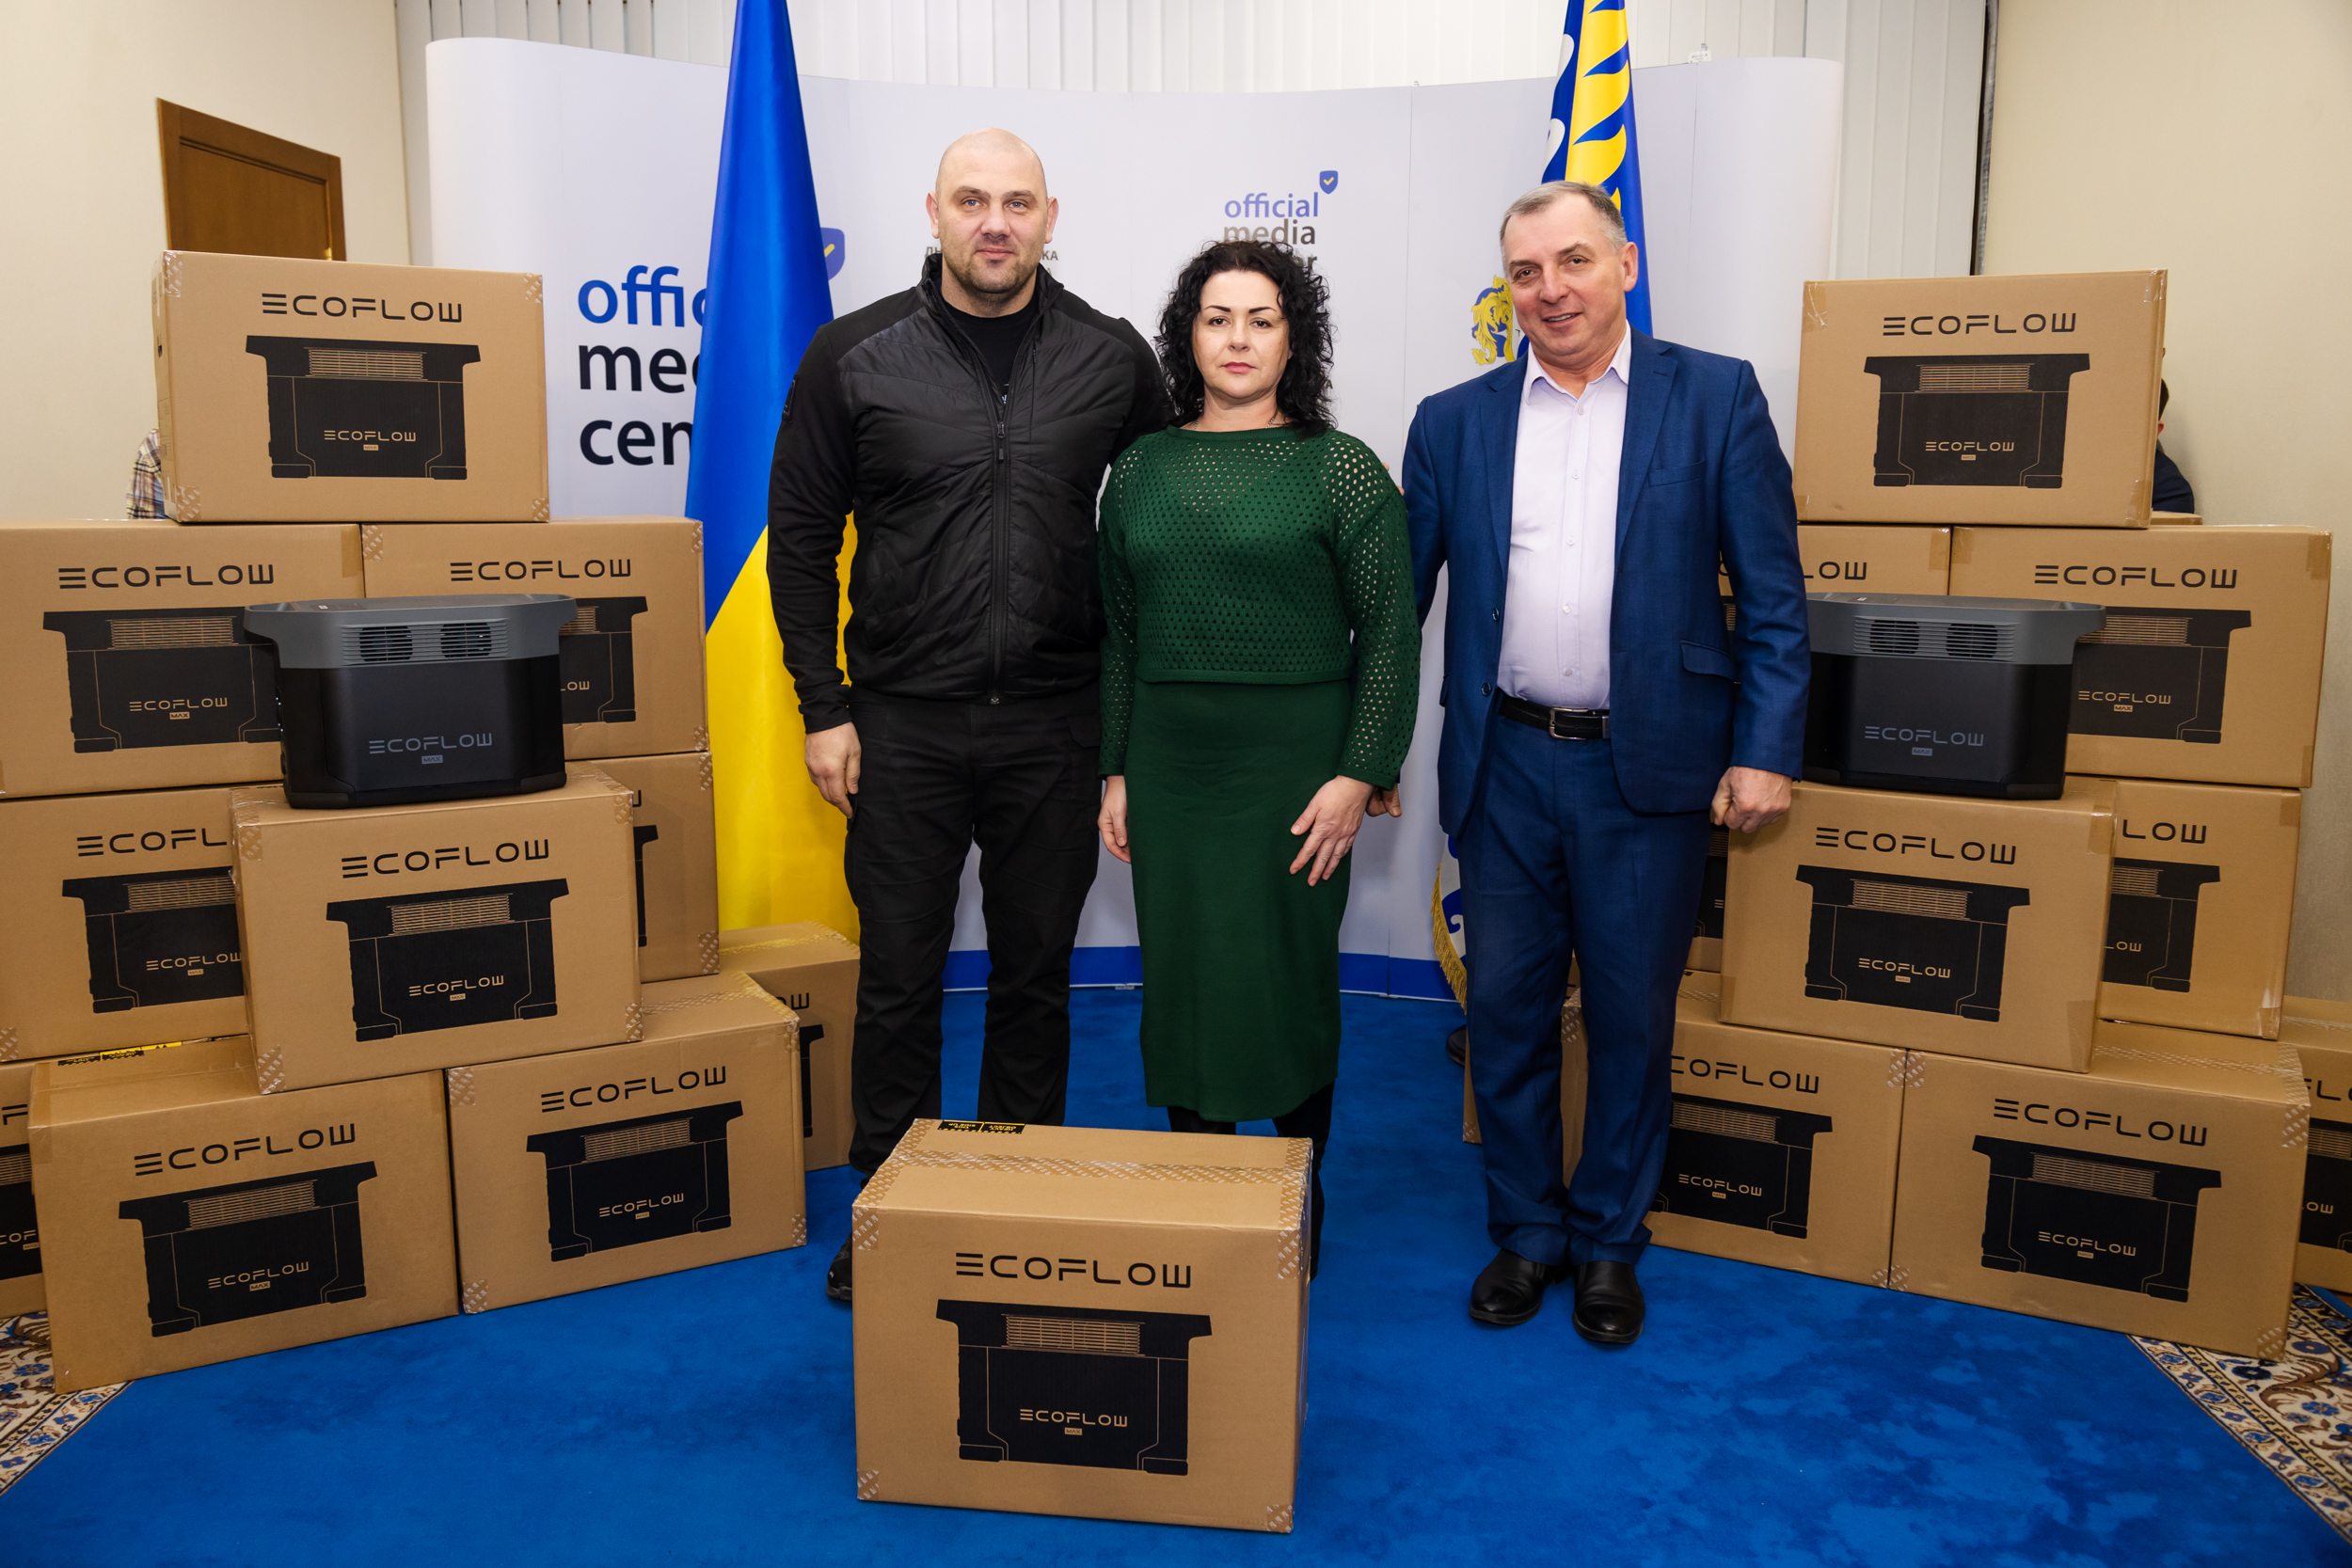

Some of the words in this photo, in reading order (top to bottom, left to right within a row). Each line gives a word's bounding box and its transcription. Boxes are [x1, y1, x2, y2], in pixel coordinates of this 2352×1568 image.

[1224, 191, 1319, 218] official
[1223, 218, 1316, 245] media
[261, 293, 463, 324] ECOFLOW
[1883, 312, 2076, 337] ECOFLOW
[324, 429, 417, 442] ECOFLOW
[1925, 440, 2015, 452] ECOFLOW
[57, 563, 275, 590] ECOFLOW
[450, 558, 631, 582] ECOFLOW
[2034, 564, 2238, 590] ECOFLOW
[129, 697, 229, 712] ECOFLOW
[2077, 689, 2171, 705] ECOFLOW
[368, 732, 493, 754] ECOFLOW
[1864, 725, 1985, 747] ECOFLOW
[422, 755, 442, 764] MAX
[1815, 826, 2017, 865] ECOFLOW
[341, 838, 549, 879] ECOFLOW
[1858, 958, 1951, 979] ECOFLOW
[408, 974, 504, 997] ECOFLOW
[540, 1065, 726, 1113] ECOFLOW
[1993, 1098, 2208, 1148] ECOFLOW
[134, 1123, 356, 1177] ECOFLOW
[1678, 1173, 1763, 1196] ECOFLOW
[598, 1192, 685, 1218] ECOFLOW
[2038, 1230, 2137, 1258] ECOFLOW
[207, 1260, 310, 1290] ECOFLOW
[955, 1252, 1191, 1289] ECOFLOW
[250, 1282, 270, 1291] MAX
[1019, 1408, 1128, 1428] ECOFLOW
